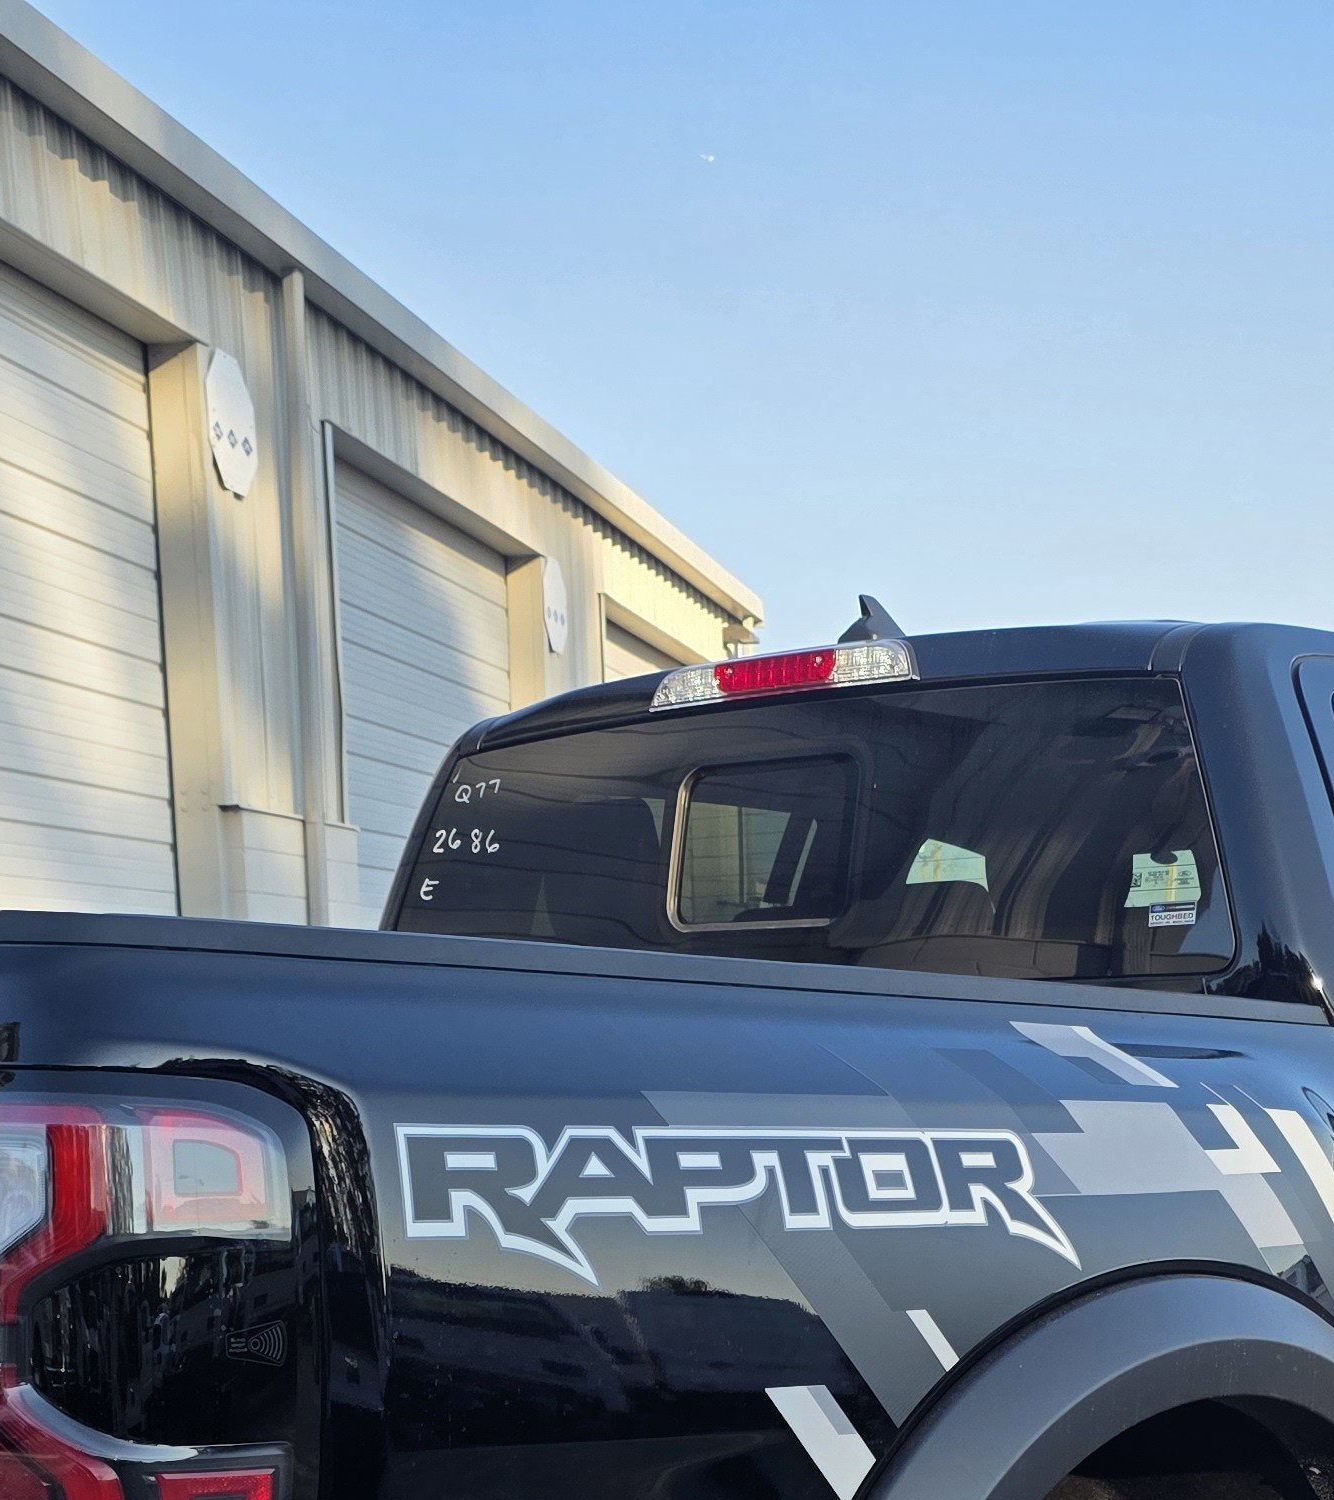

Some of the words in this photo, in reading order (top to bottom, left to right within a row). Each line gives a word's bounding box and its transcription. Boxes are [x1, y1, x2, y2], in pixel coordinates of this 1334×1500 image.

[419, 877, 440, 901] E
[1150, 912, 1194, 921] TOUGHBED
[393, 1123, 1081, 1286] RAPTOR
